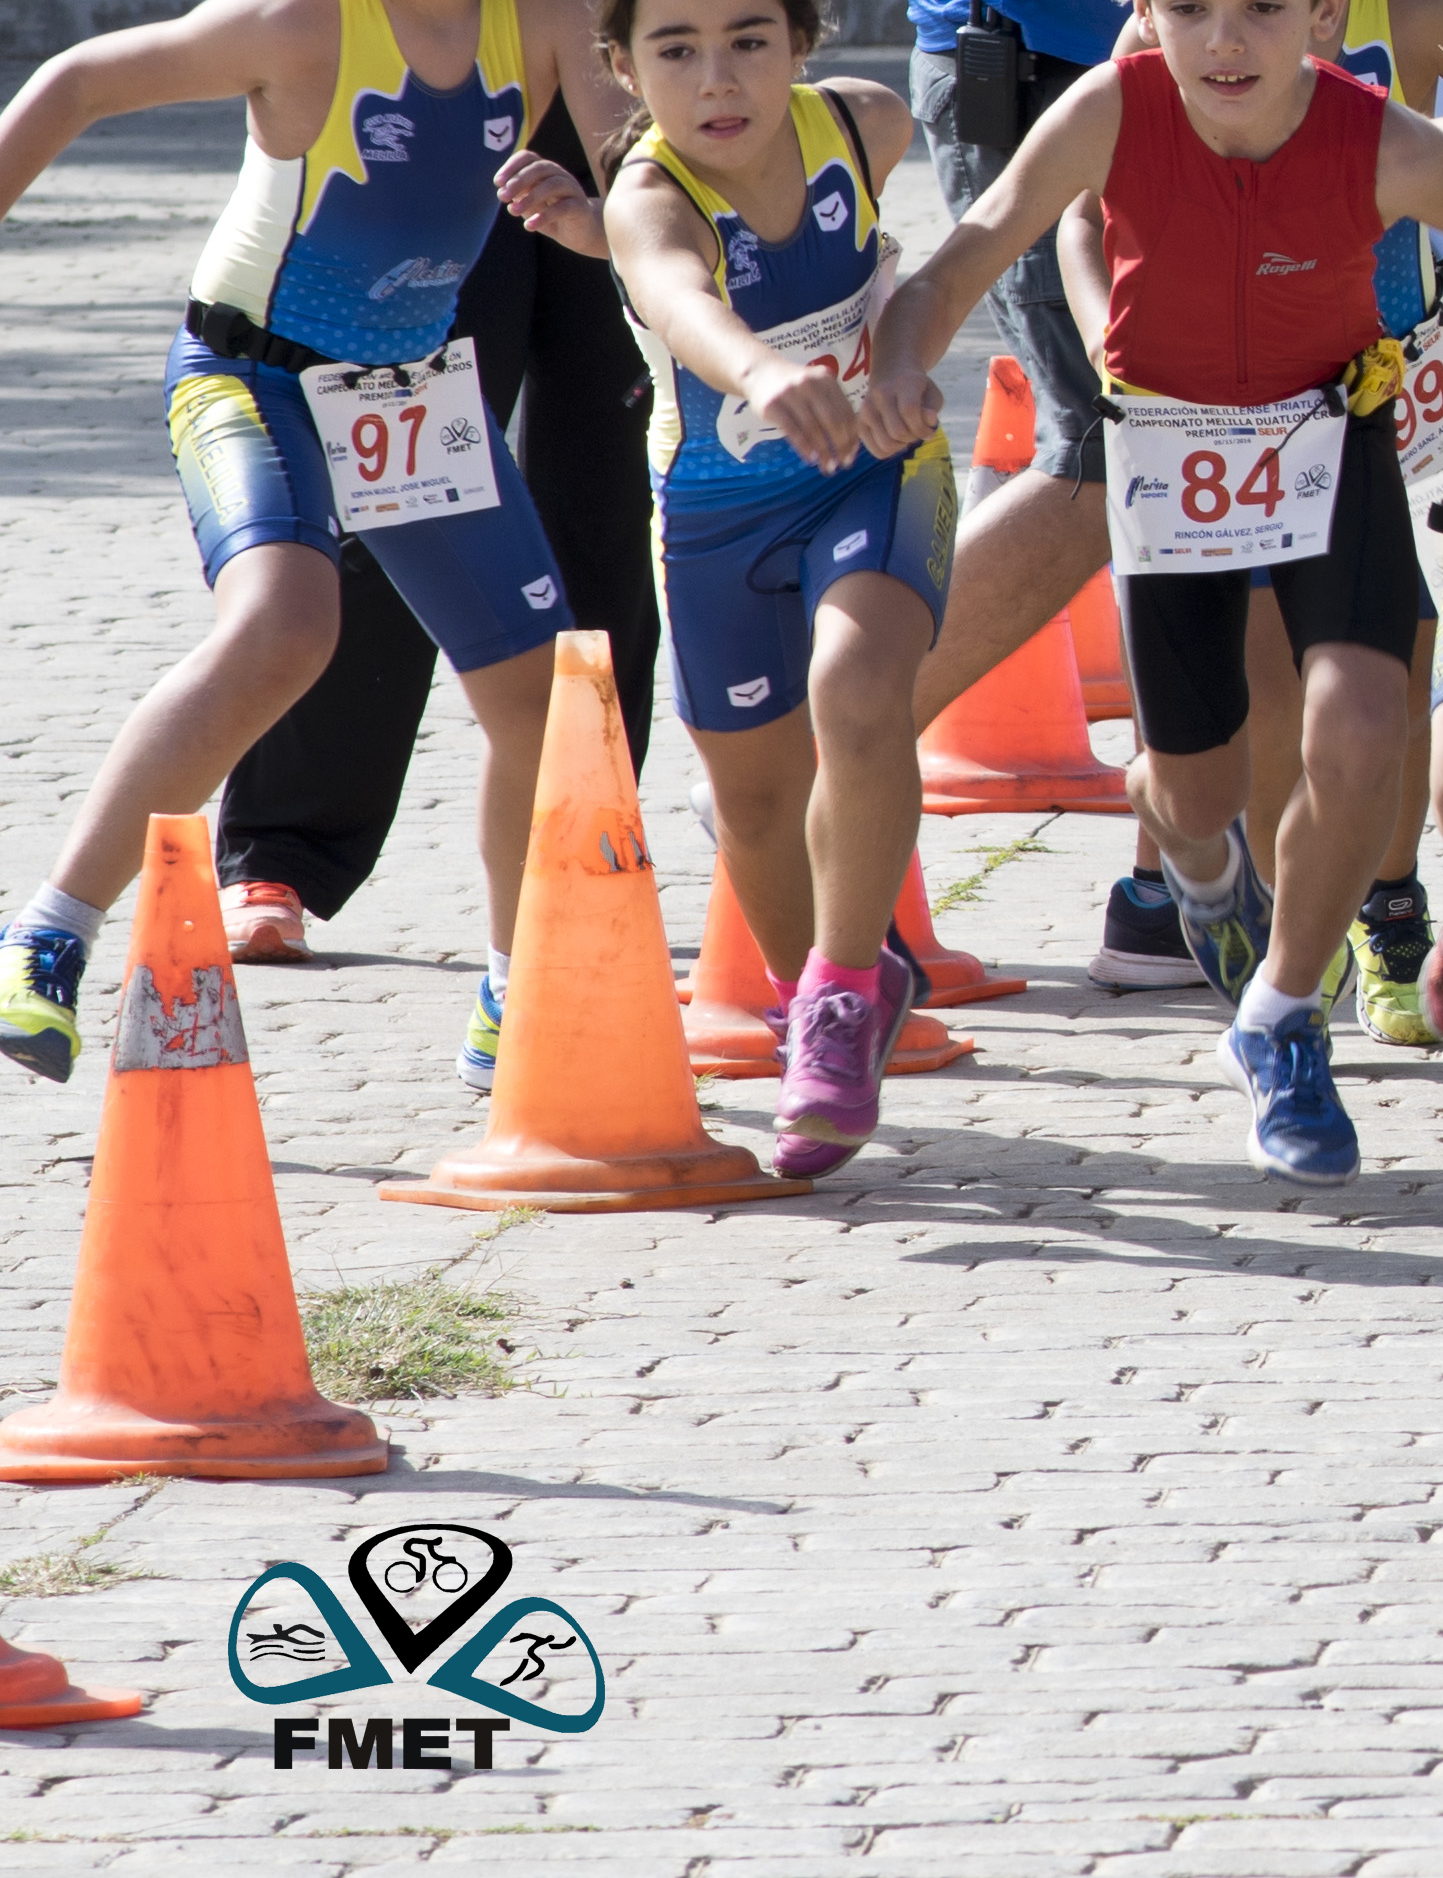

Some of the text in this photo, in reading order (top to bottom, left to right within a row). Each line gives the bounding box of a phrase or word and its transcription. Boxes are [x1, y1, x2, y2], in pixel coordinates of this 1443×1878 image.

[823, 307, 864, 335] MELILLA
[804, 329, 841, 351] PREMIO
[447, 361, 473, 374] CROS
[1128, 403, 1270, 418] FEDERACIÓN MELILLENSE
[1129, 413, 1309, 428] CAMPEONATO MELILLA DUATLON
[1186, 427, 1288, 438] PREMIO SEUR
[351, 405, 427, 482] 97
[1181, 447, 1285, 523] 84
[1175, 528, 1214, 540] RINCÓN
[1255, 522, 1284, 535] SERGIO
